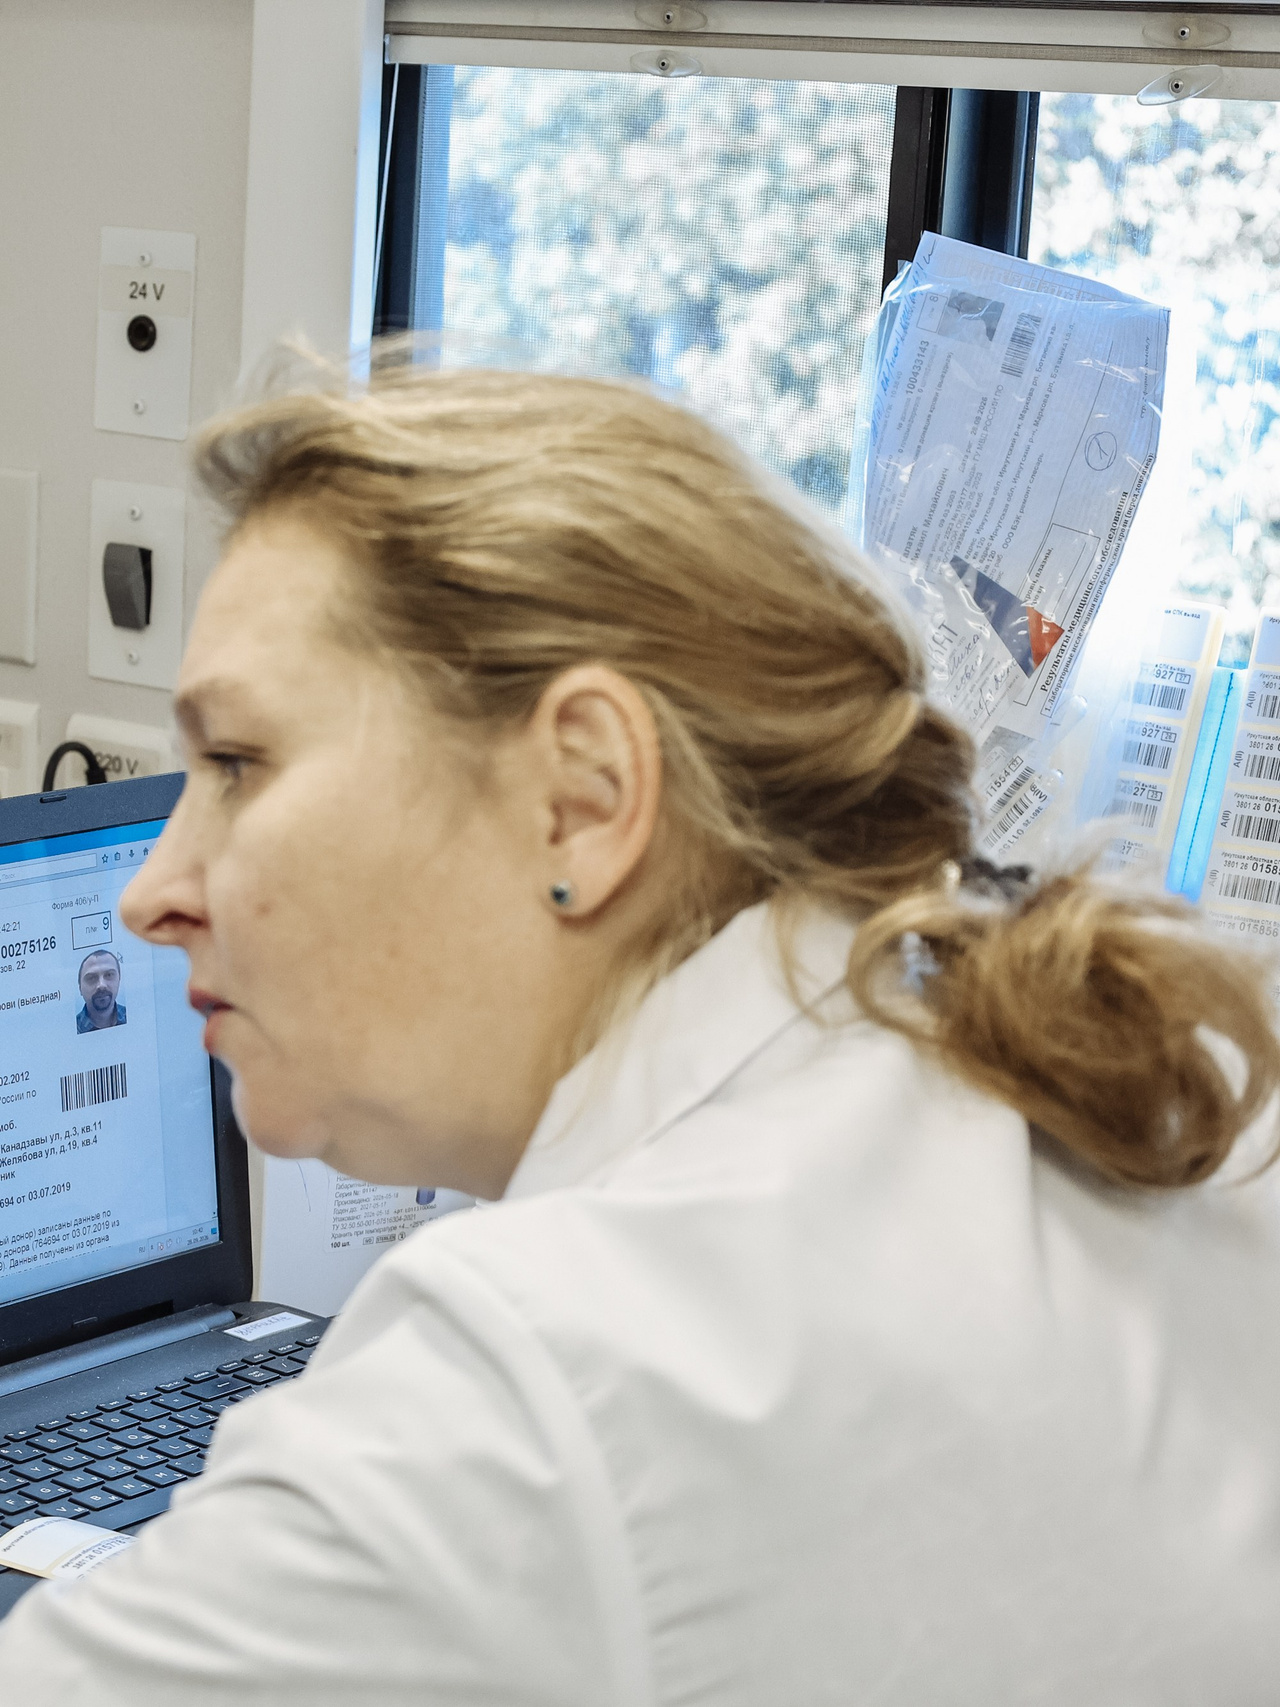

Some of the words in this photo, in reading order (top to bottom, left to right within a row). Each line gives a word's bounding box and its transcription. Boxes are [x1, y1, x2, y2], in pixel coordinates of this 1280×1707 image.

[129, 281, 147, 299] 24
[152, 283, 165, 300] V
[904, 339, 931, 396] 100433143
[921, 466, 951, 528] Михайлович
[1038, 633, 1075, 694] Результаты
[1065, 562, 1105, 634] медицинского
[1097, 490, 1131, 564] обследования
[1046, 651, 1077, 705] Лабораторные
[126, 758, 139, 776] V
[1236, 801, 1252, 809] 3801
[1220, 810, 1232, 828] A(II)
[1223, 860, 1239, 869] 3801
[51, 900, 74, 911] Форма
[102, 916, 110, 931] 9
[1239, 922, 1278, 937] 015856
[15, 959, 26, 971] 22
[17, 989, 61, 1010] (выездная)
[26, 1089, 37, 1099] по
[0, 1135, 48, 1154] Канадзавы
[81, 1120, 102, 1135] кв.11
[81, 1134, 98, 1148] кв.4
[16, 1194, 26, 1205] от
[28, 1181, 71, 1202] 03.07.2019
